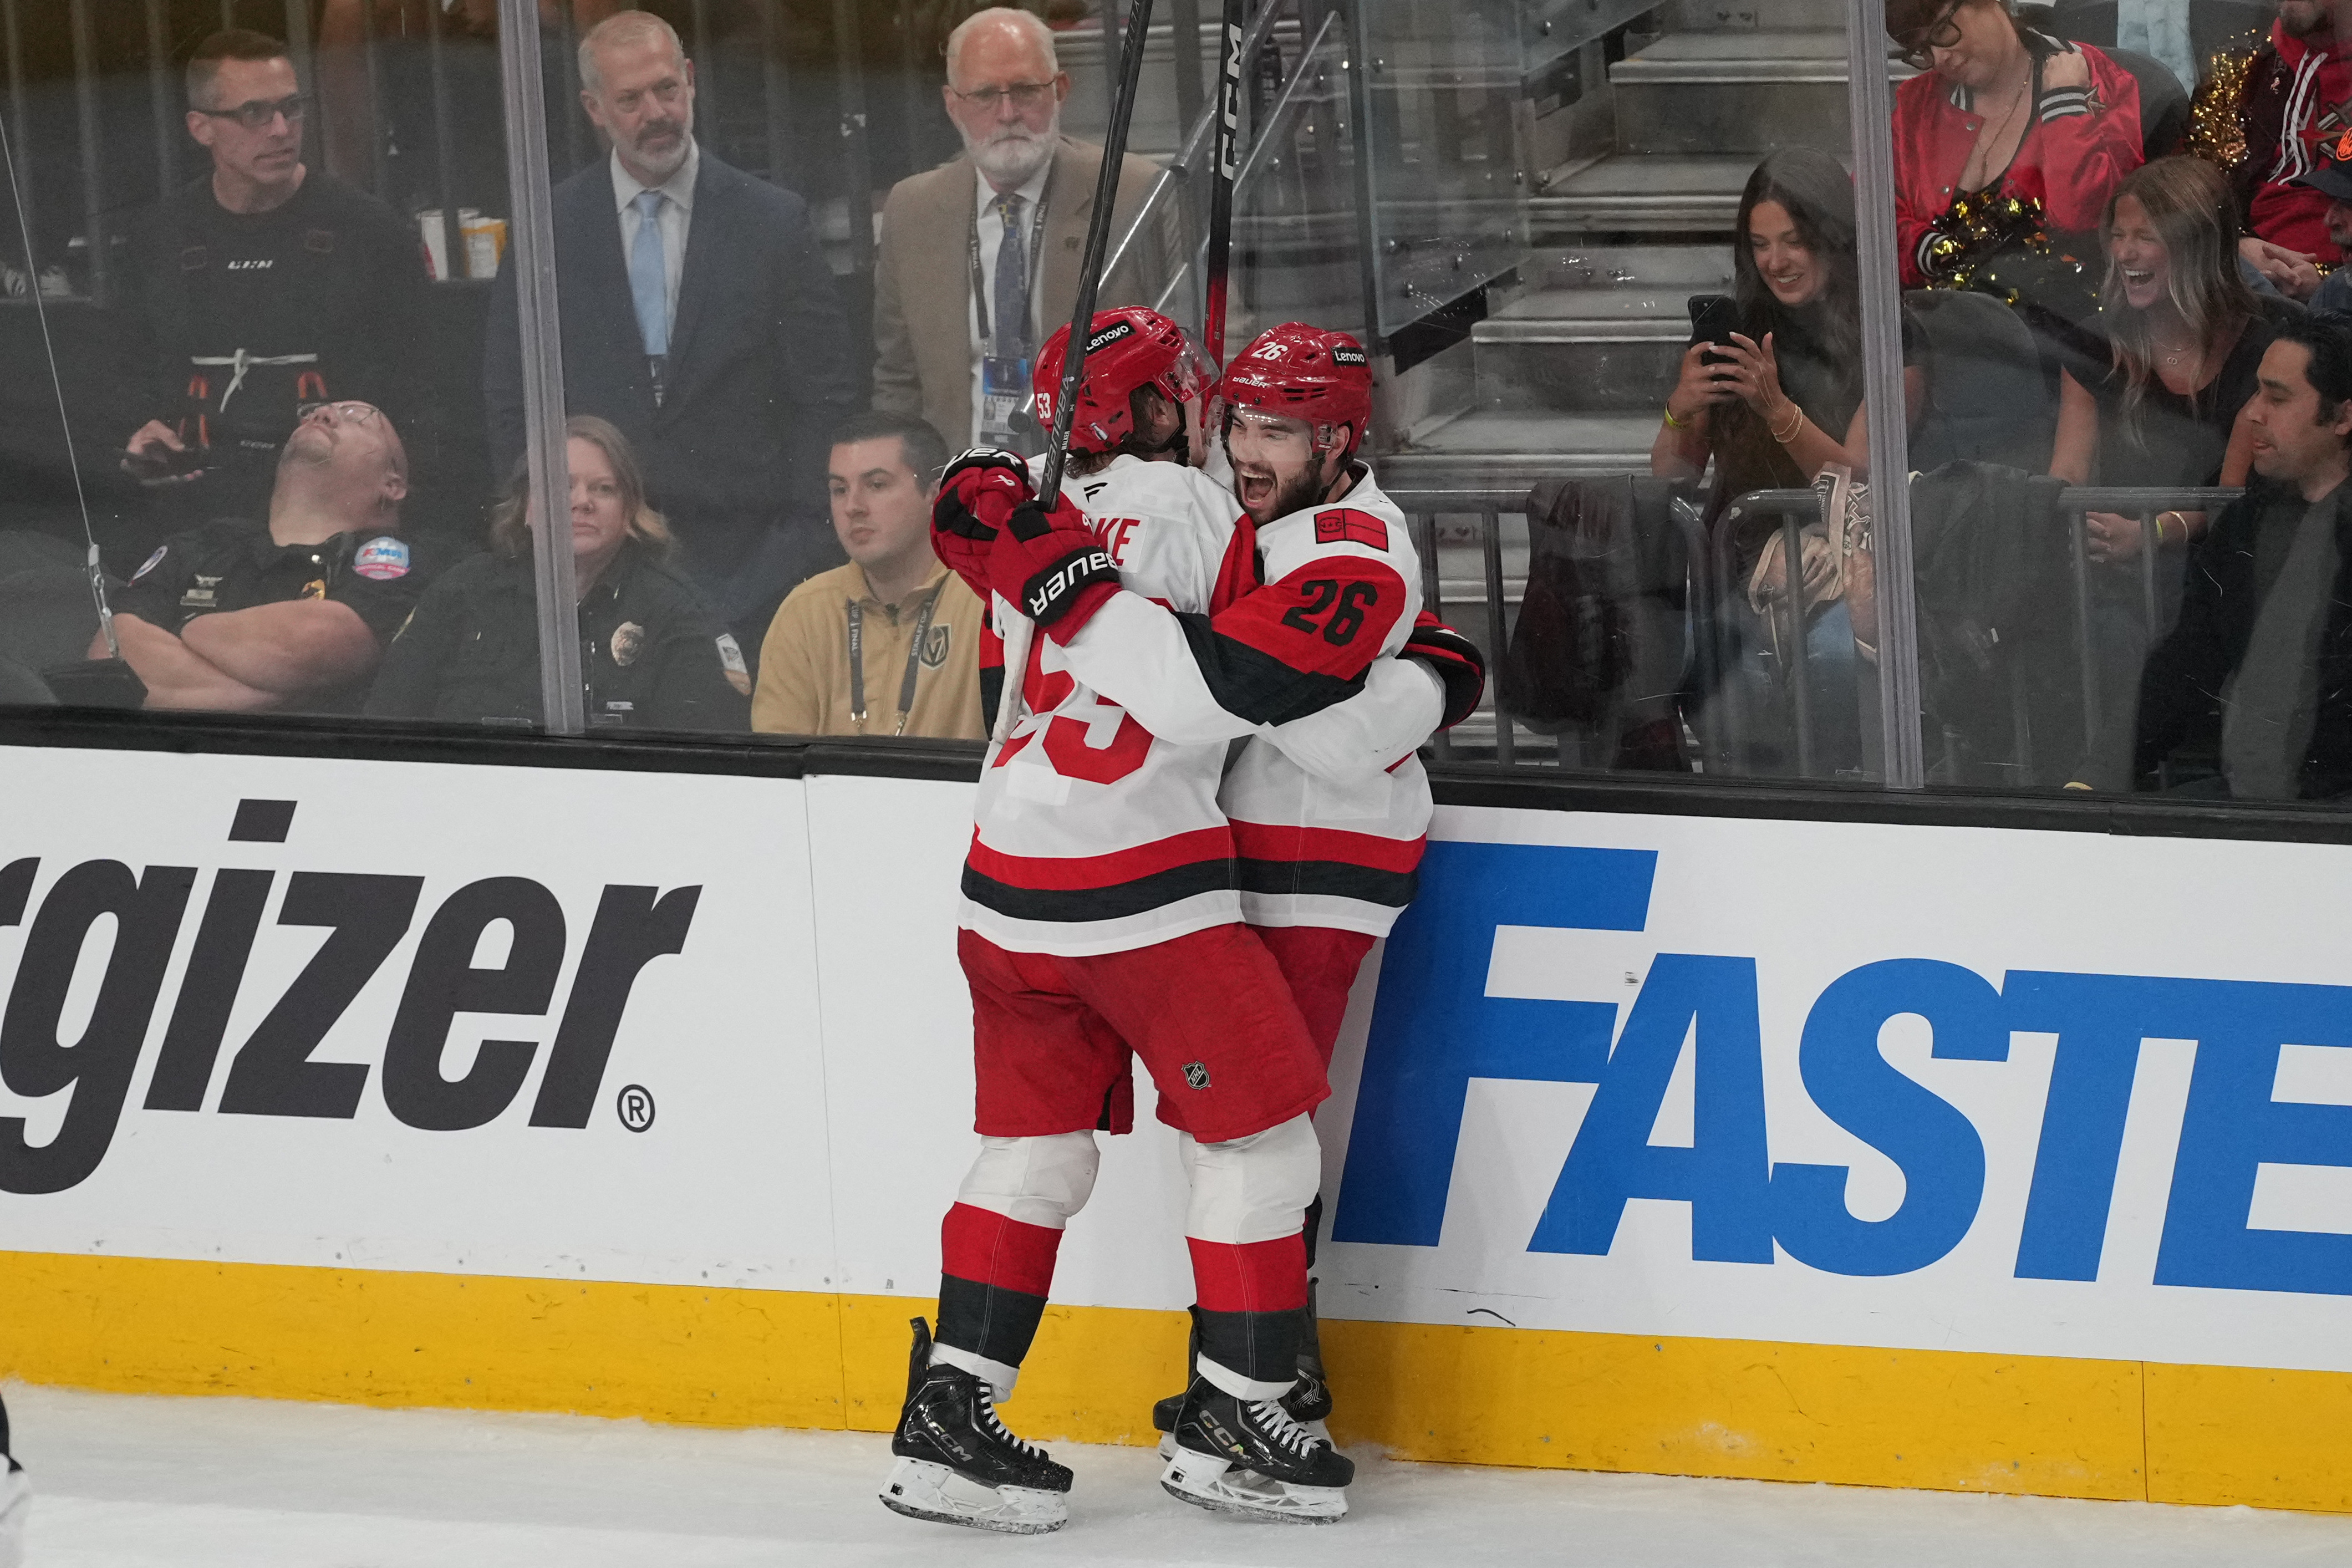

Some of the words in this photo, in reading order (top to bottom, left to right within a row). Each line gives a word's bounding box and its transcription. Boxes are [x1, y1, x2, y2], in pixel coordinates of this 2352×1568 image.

[1221, 23, 1242, 181] CCM
[1250, 341, 1289, 361] 26
[1334, 350, 1366, 363] Lenovo
[1037, 392, 1052, 419] 53
[1061, 430, 1071, 451] WALKER
[1281, 579, 1378, 647] 26
[1190, 1067, 1202, 1085] NHL
